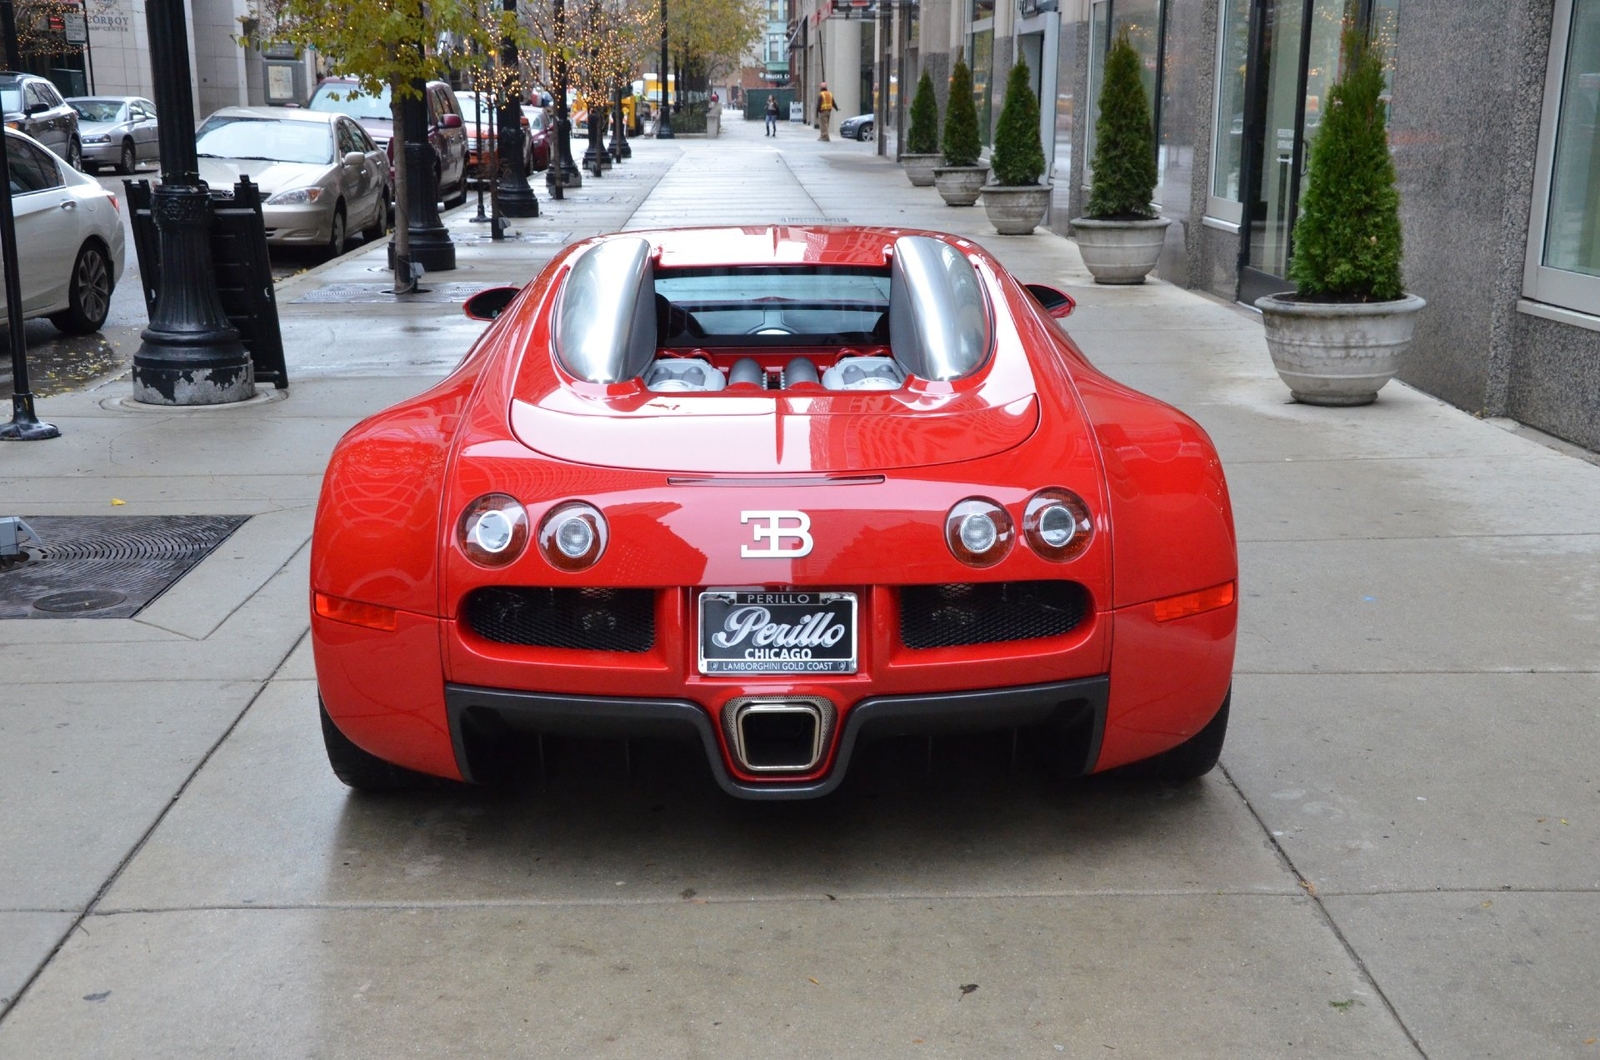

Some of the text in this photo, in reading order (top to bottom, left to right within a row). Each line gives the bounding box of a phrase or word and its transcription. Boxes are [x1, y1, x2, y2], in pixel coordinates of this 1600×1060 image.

[747, 594, 810, 604] PERILLO
[712, 606, 846, 648] Perillo
[744, 648, 812, 659] CHICAGO
[722, 662, 833, 671] LAMBORGHINI GOLD COAST
